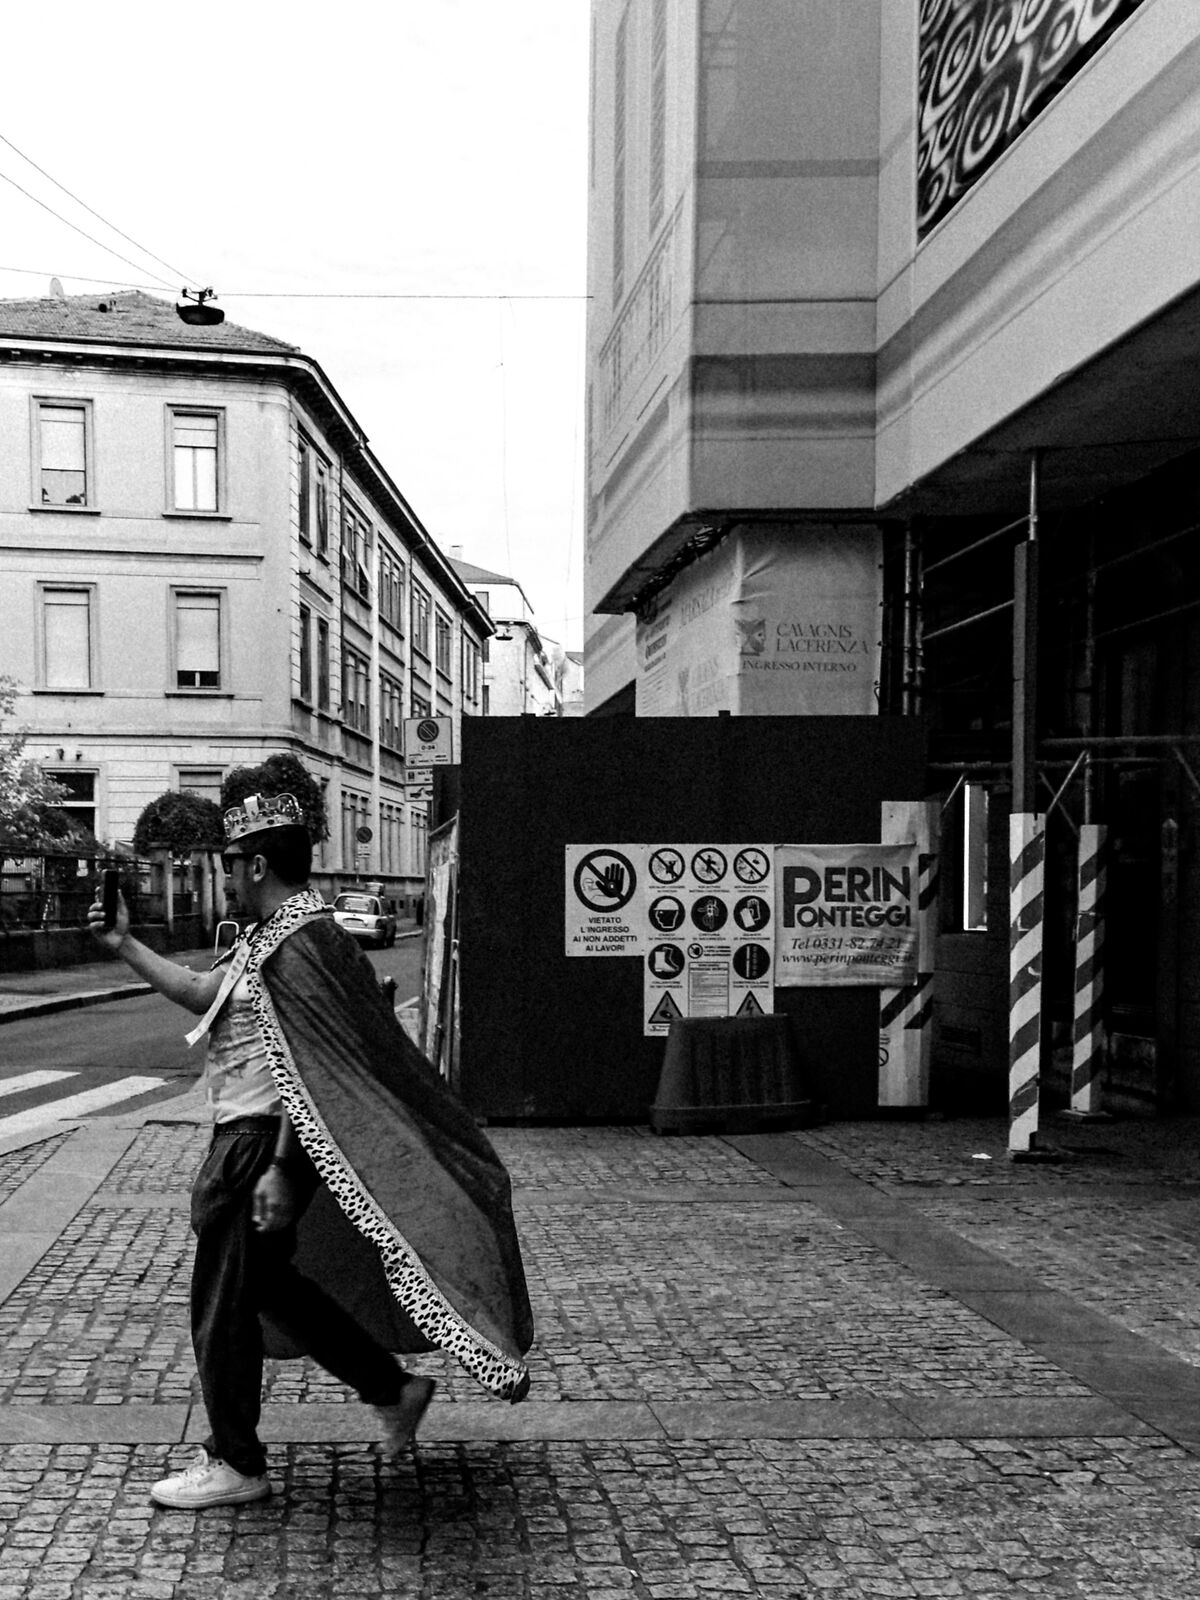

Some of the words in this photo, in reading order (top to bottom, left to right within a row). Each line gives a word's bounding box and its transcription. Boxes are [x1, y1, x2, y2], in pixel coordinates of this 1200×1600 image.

[742, 659, 800, 671] INGRESSO
[802, 660, 856, 672] INTERNO
[783, 866, 910, 910] PERIN
[580, 926, 630, 934] L'INGRESSO
[583, 935, 601, 943] NON
[603, 935, 638, 943] ADDETTI
